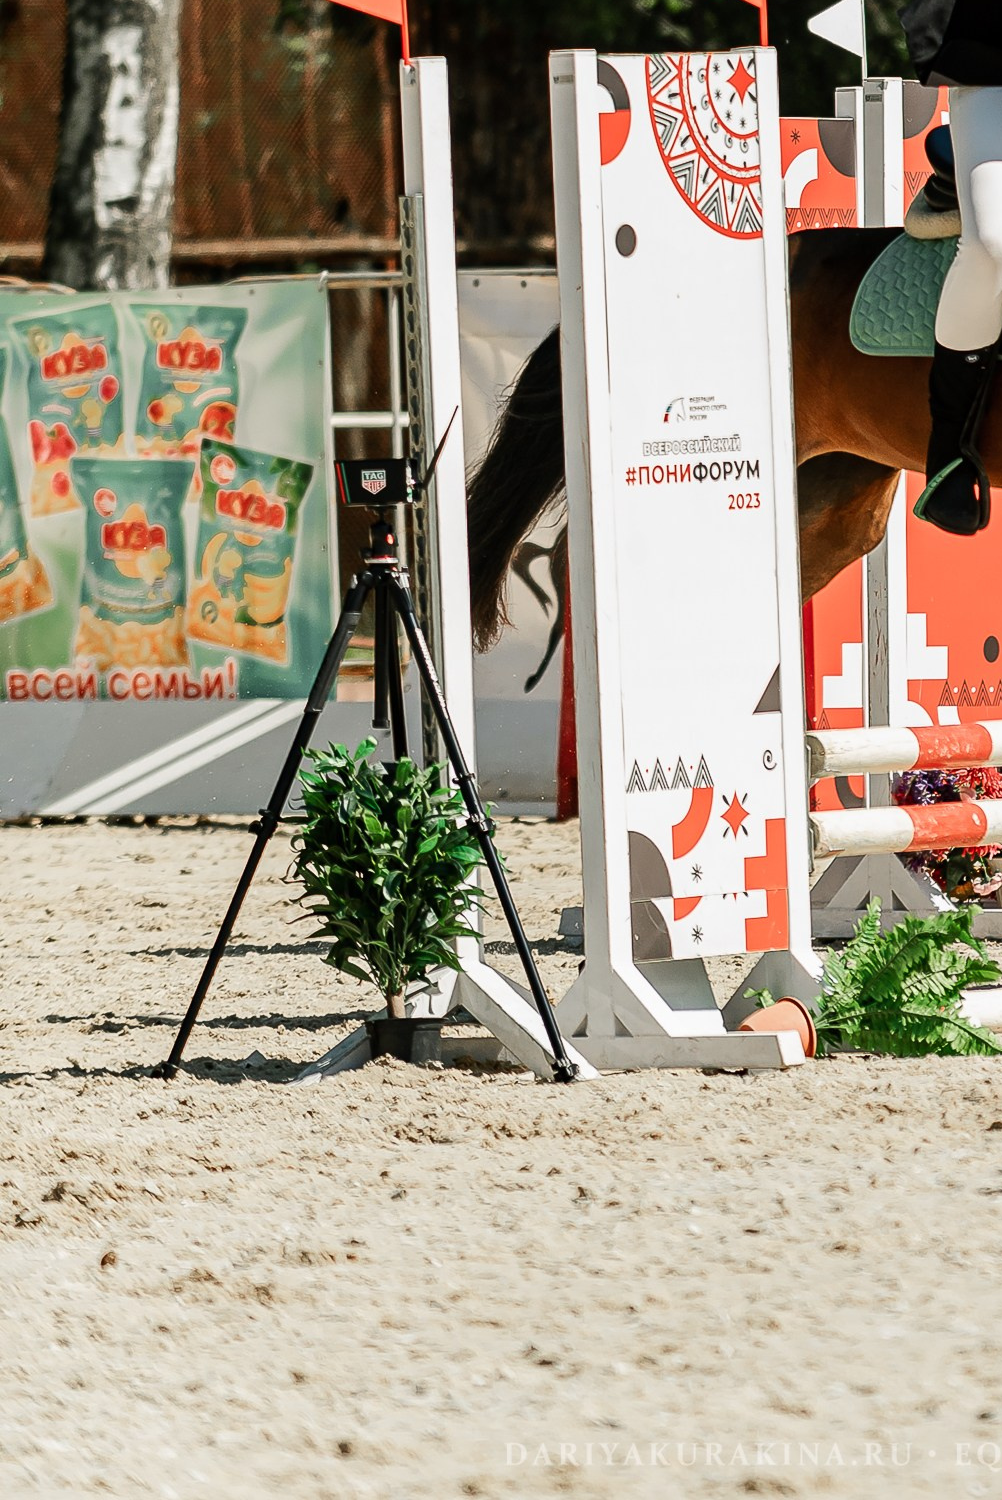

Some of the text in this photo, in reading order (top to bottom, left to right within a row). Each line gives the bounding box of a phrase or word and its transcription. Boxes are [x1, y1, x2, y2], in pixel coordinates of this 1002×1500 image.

[643, 434, 741, 457] ВСЕРОССИЙСКИЙ
[364, 472, 384, 480] TAG
[625, 459, 760, 486] #ПОНИФОРУМ
[728, 492, 761, 510] 2023
[8, 660, 237, 701] всей семьи!
